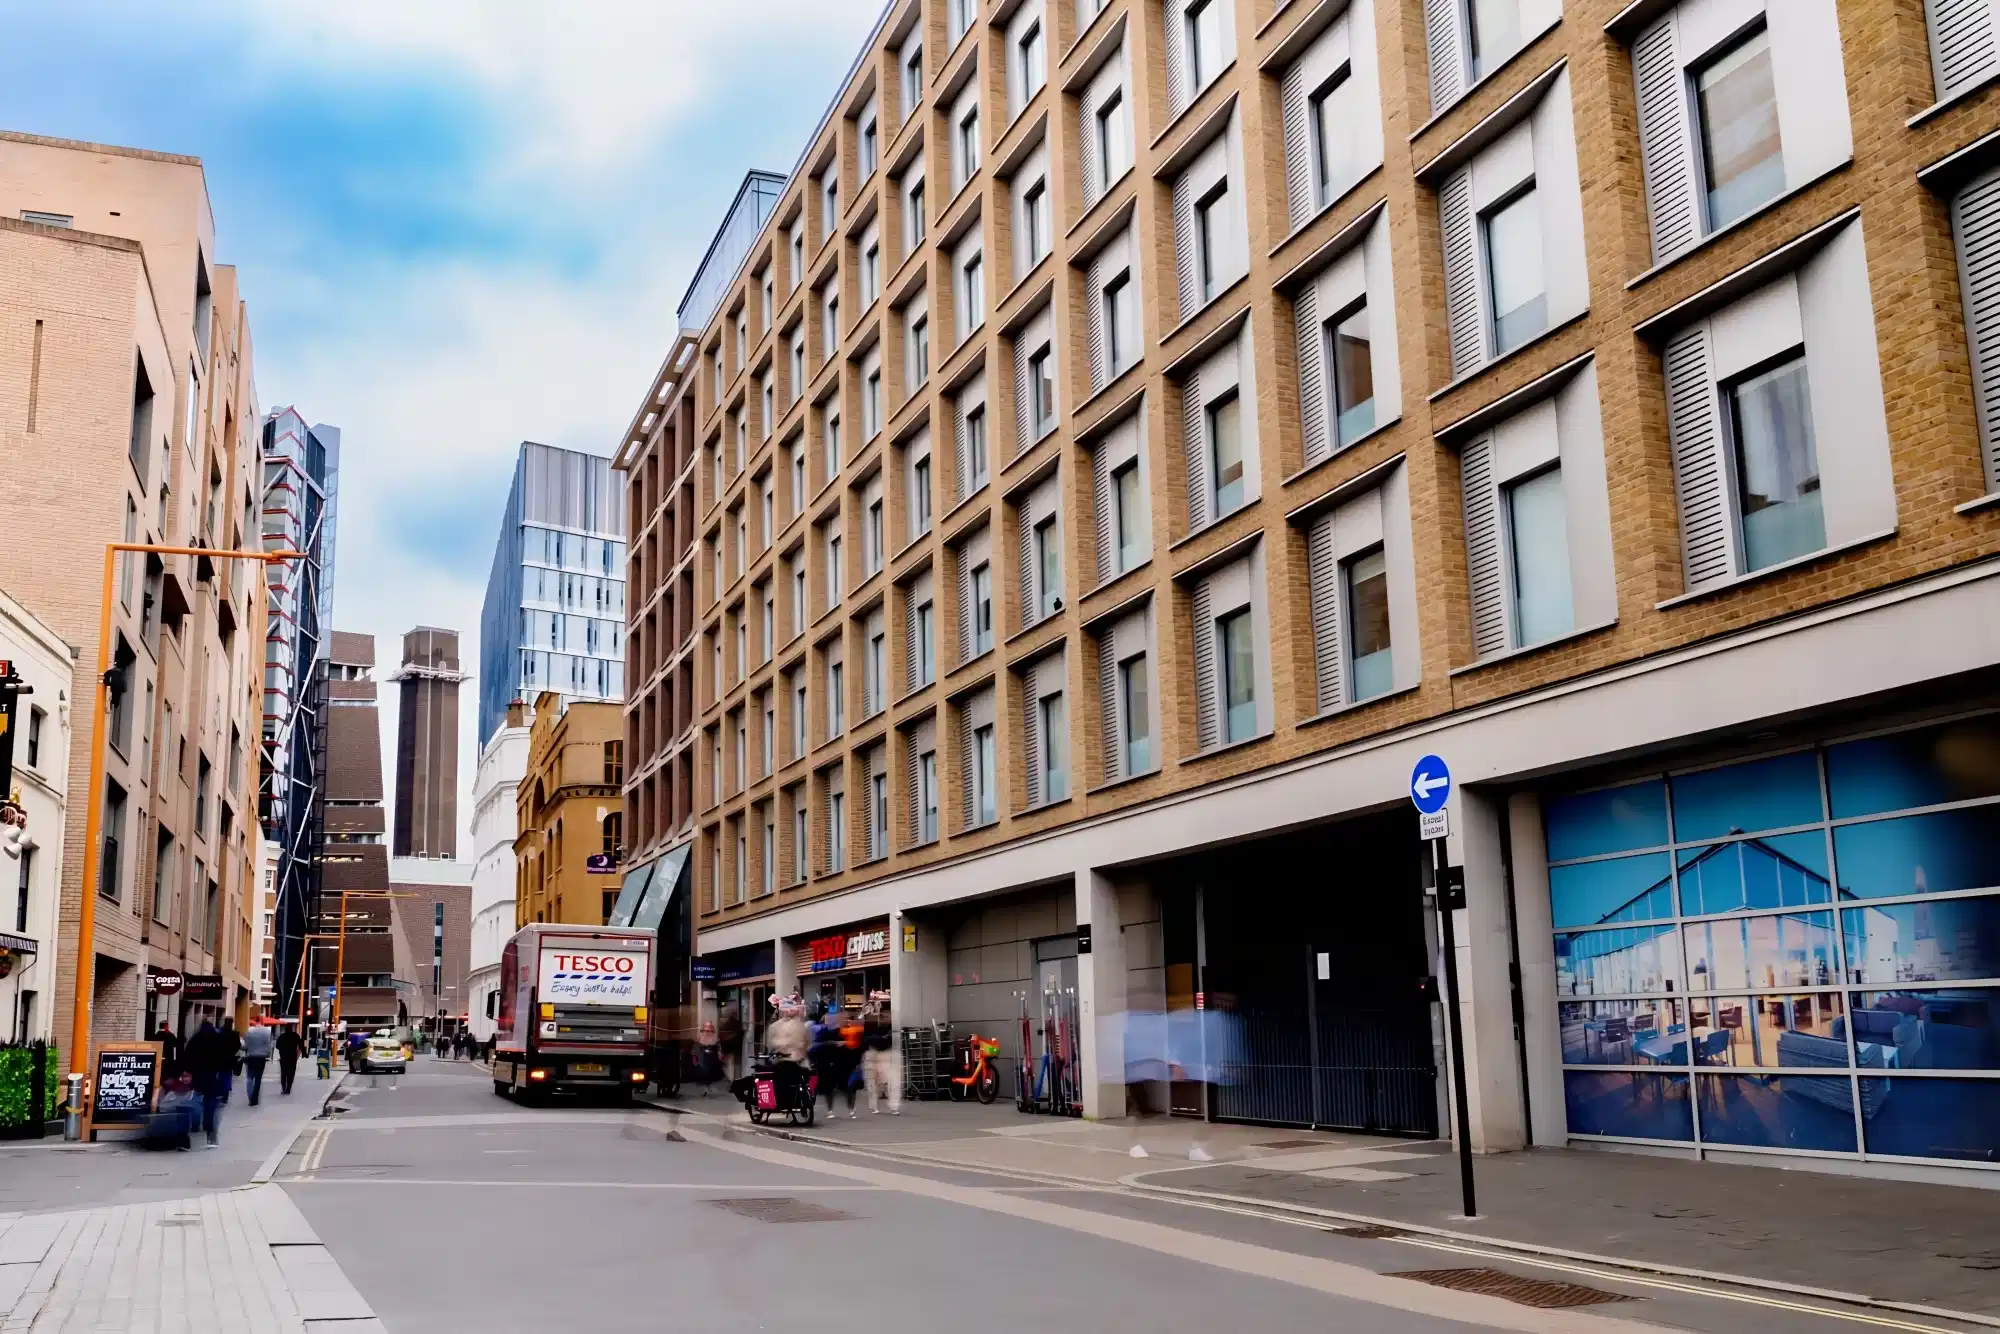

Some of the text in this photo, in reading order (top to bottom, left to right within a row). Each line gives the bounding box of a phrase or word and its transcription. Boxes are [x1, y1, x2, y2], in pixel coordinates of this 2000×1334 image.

[811, 931, 885, 961] TESCO express
[553, 955, 634, 973] TESCO
